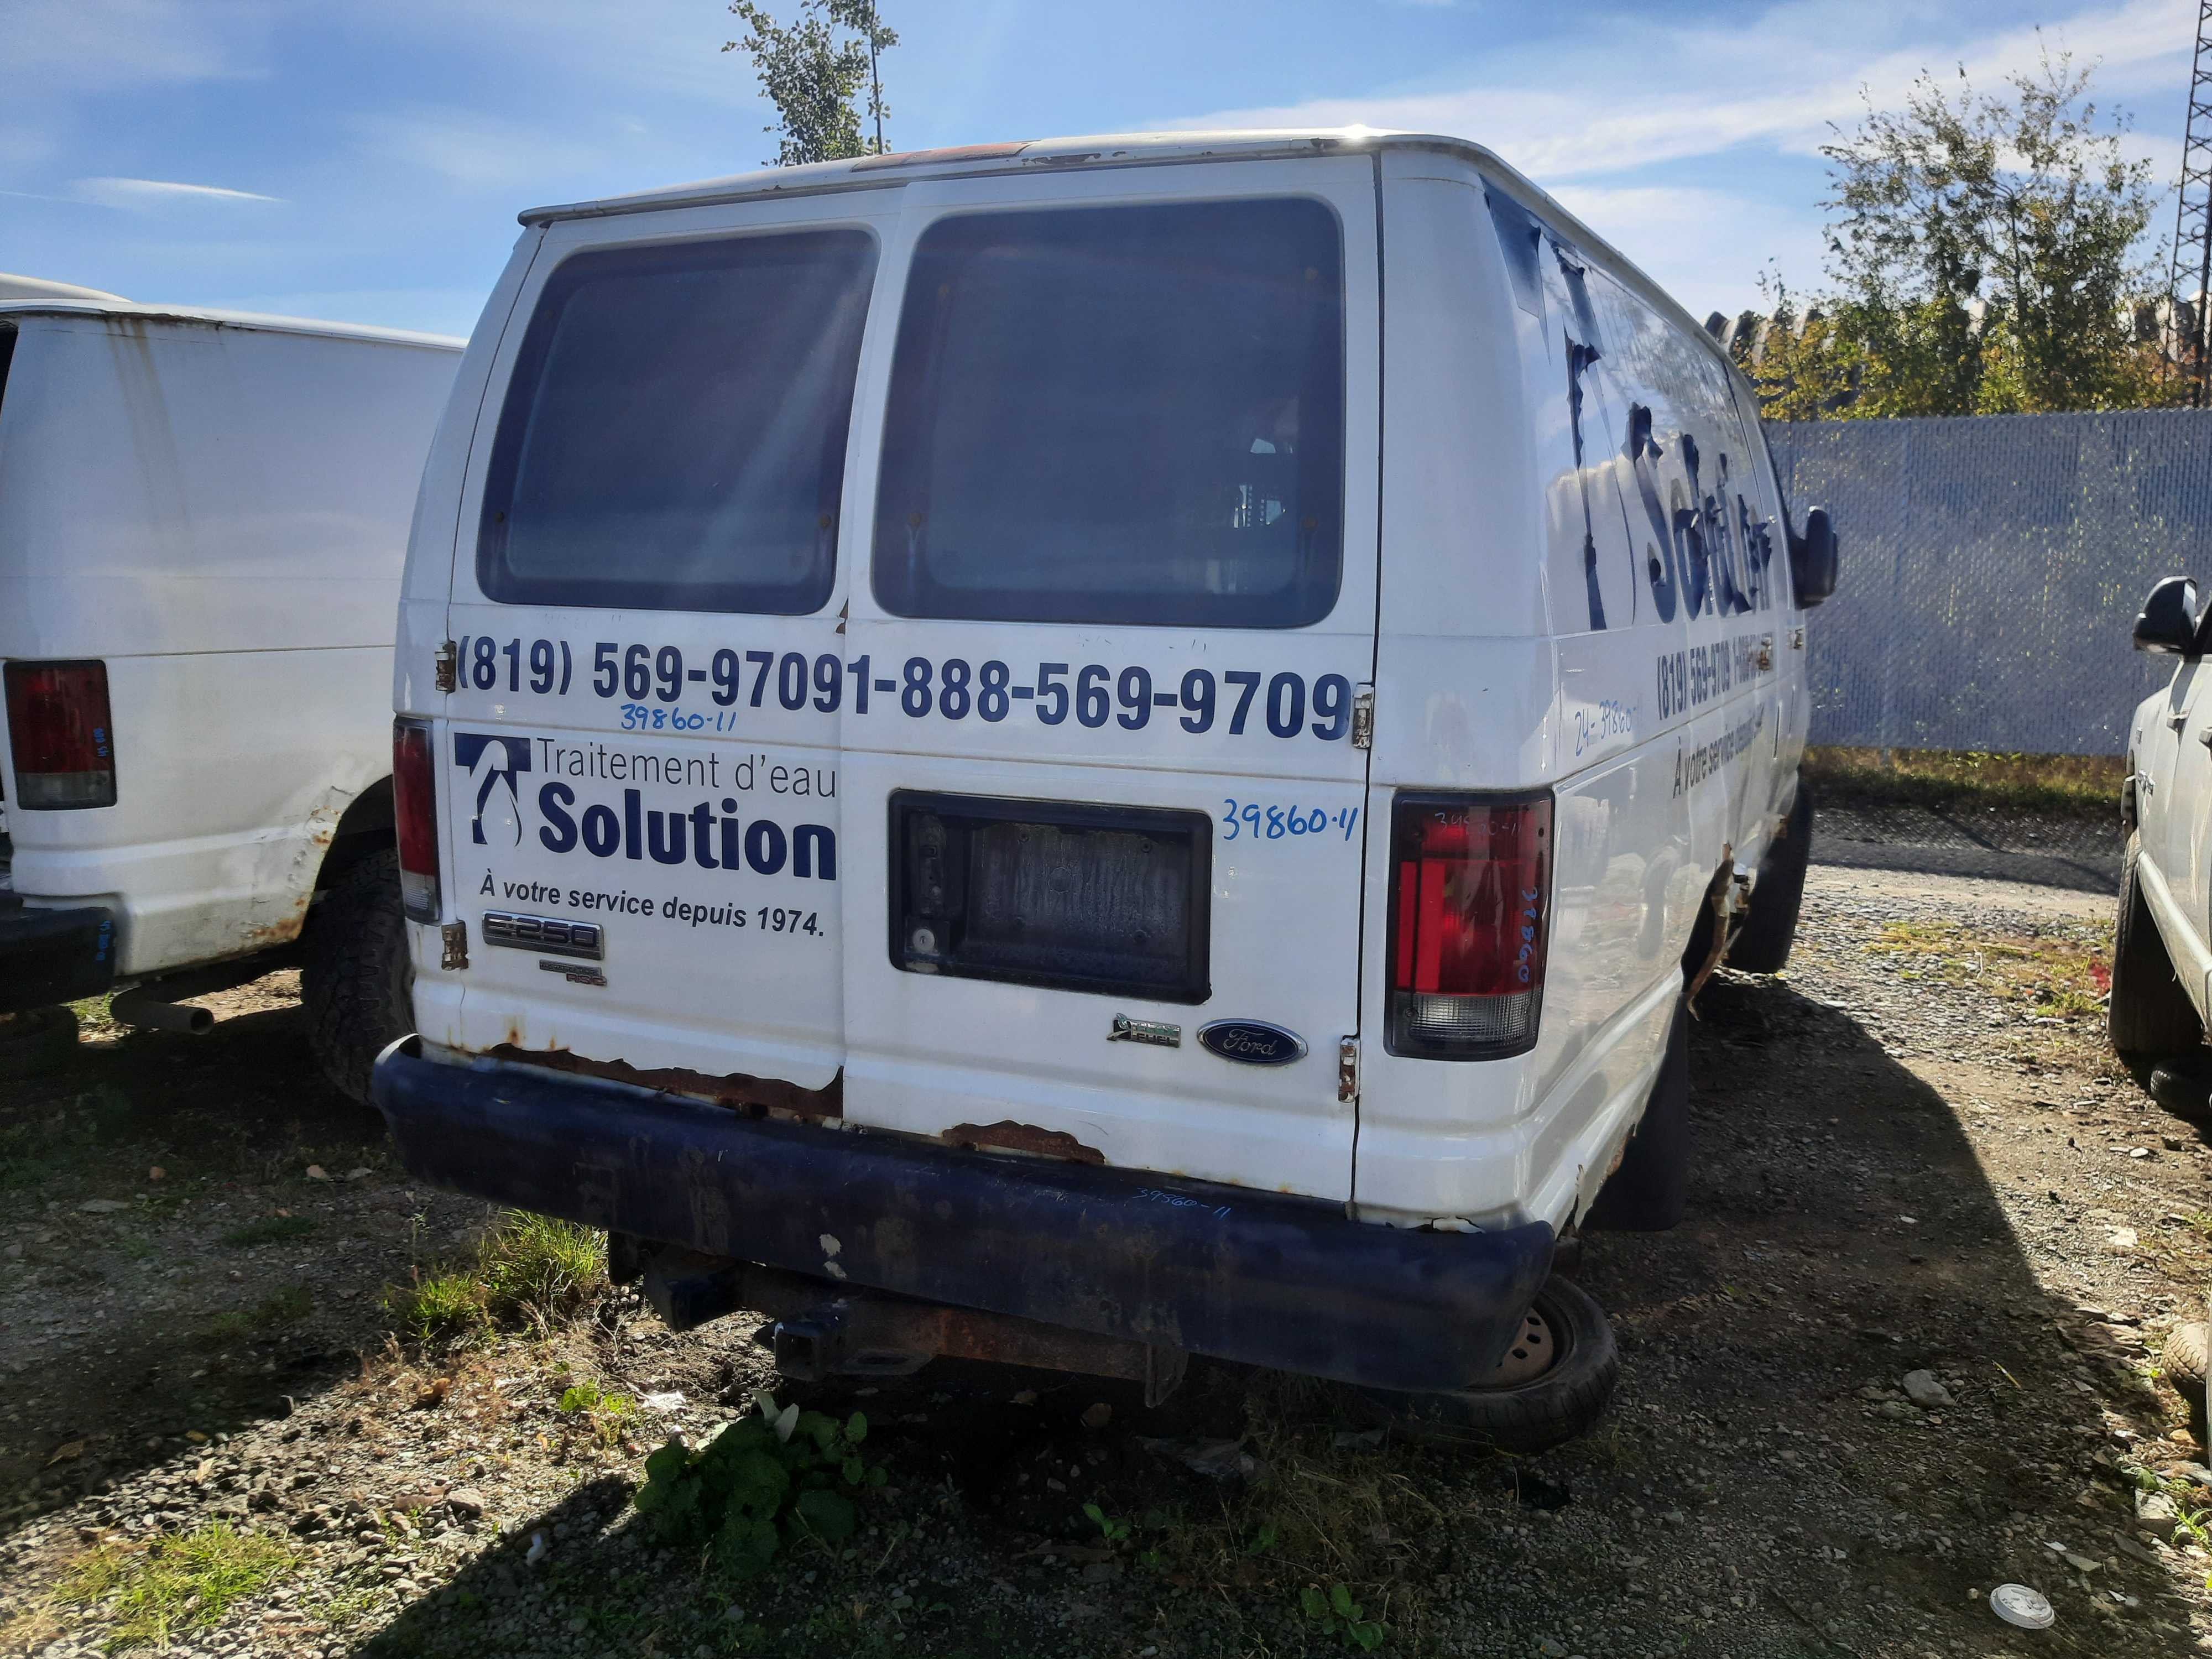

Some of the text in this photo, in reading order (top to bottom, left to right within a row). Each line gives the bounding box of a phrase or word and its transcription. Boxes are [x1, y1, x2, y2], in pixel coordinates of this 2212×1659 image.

[458, 635, 843, 714] (819) 569-9709
[847, 655, 1350, 741] 1-888-569-9709
[1657, 651, 1687, 721] (819)
[620, 703, 737, 732] 39860-11
[536, 738, 719, 788] Traitement
[538, 781, 837, 881] Solution
[479, 868, 823, 937] À votre service depuis 1974.
[1223, 1029, 1277, 1056] Ford
